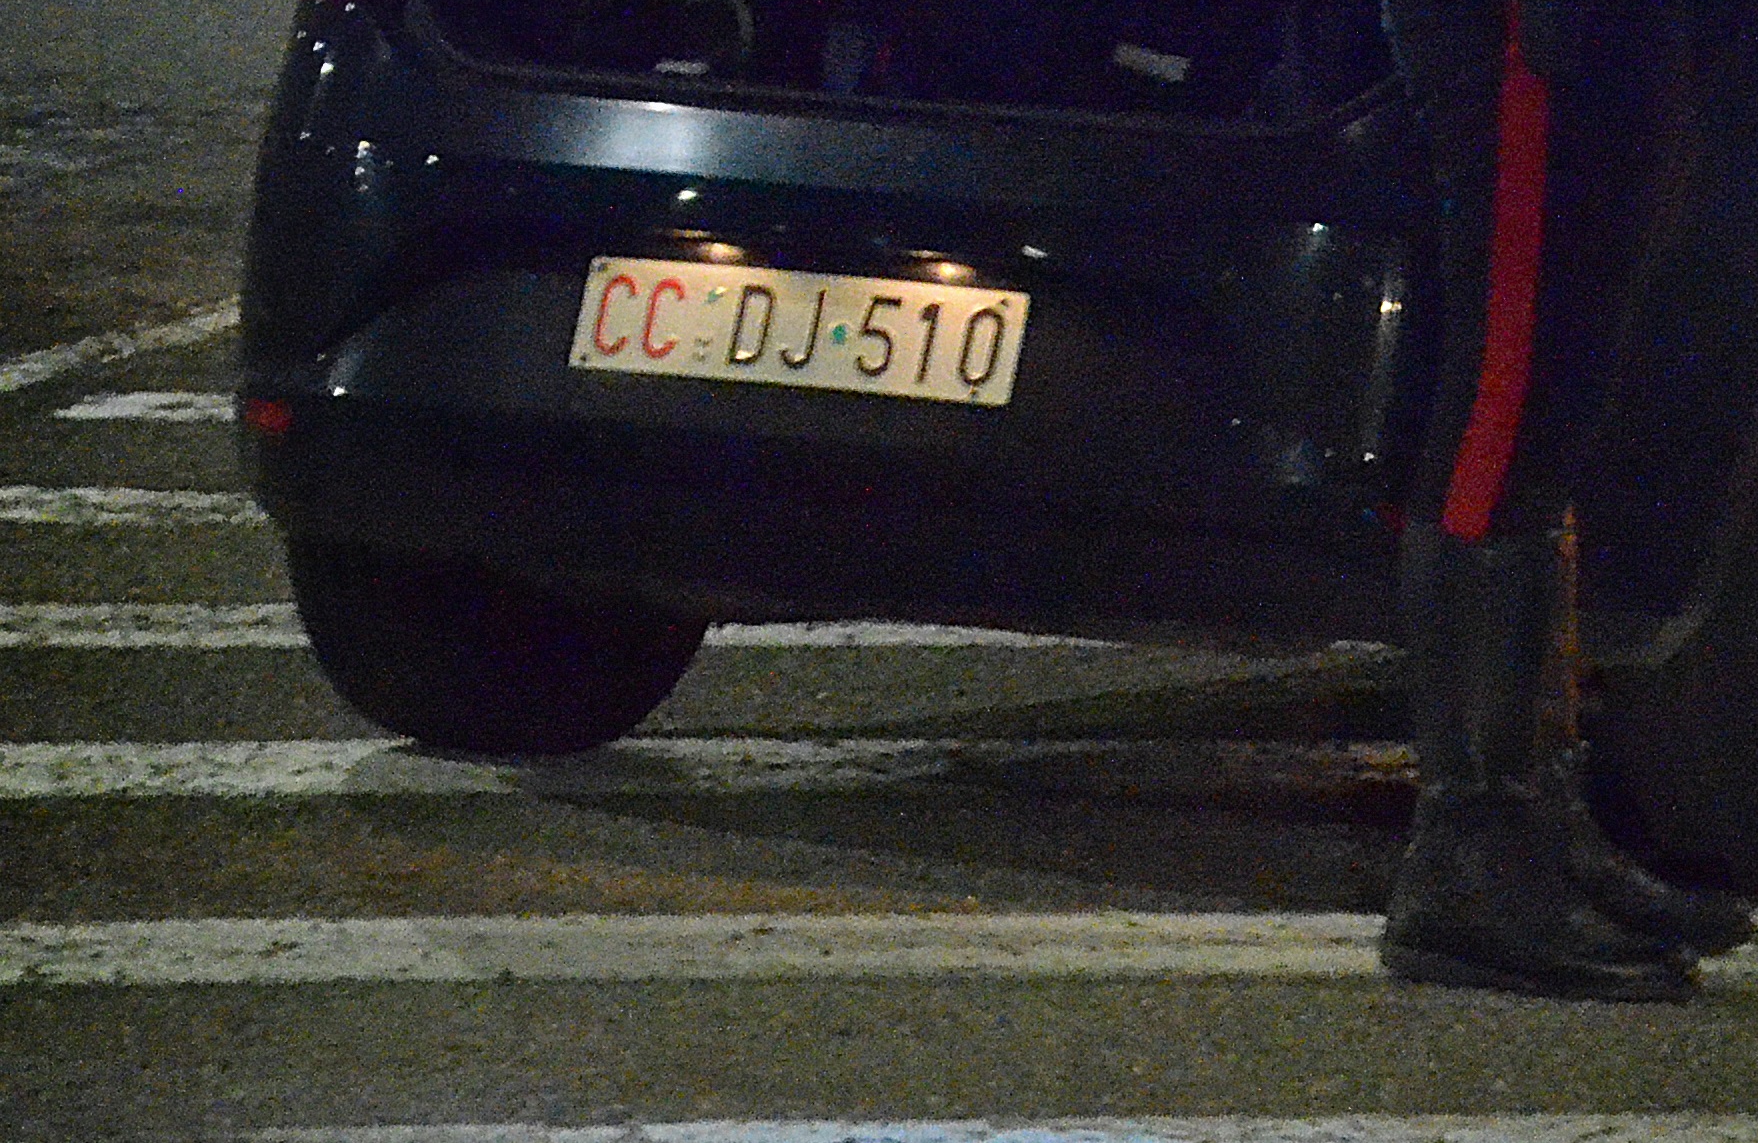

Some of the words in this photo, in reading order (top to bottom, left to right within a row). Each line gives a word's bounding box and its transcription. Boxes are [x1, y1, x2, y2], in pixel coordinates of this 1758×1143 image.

[593, 274, 686, 359] CC
[727, 284, 828, 370] DJ
[855, 295, 1004, 387] 510
